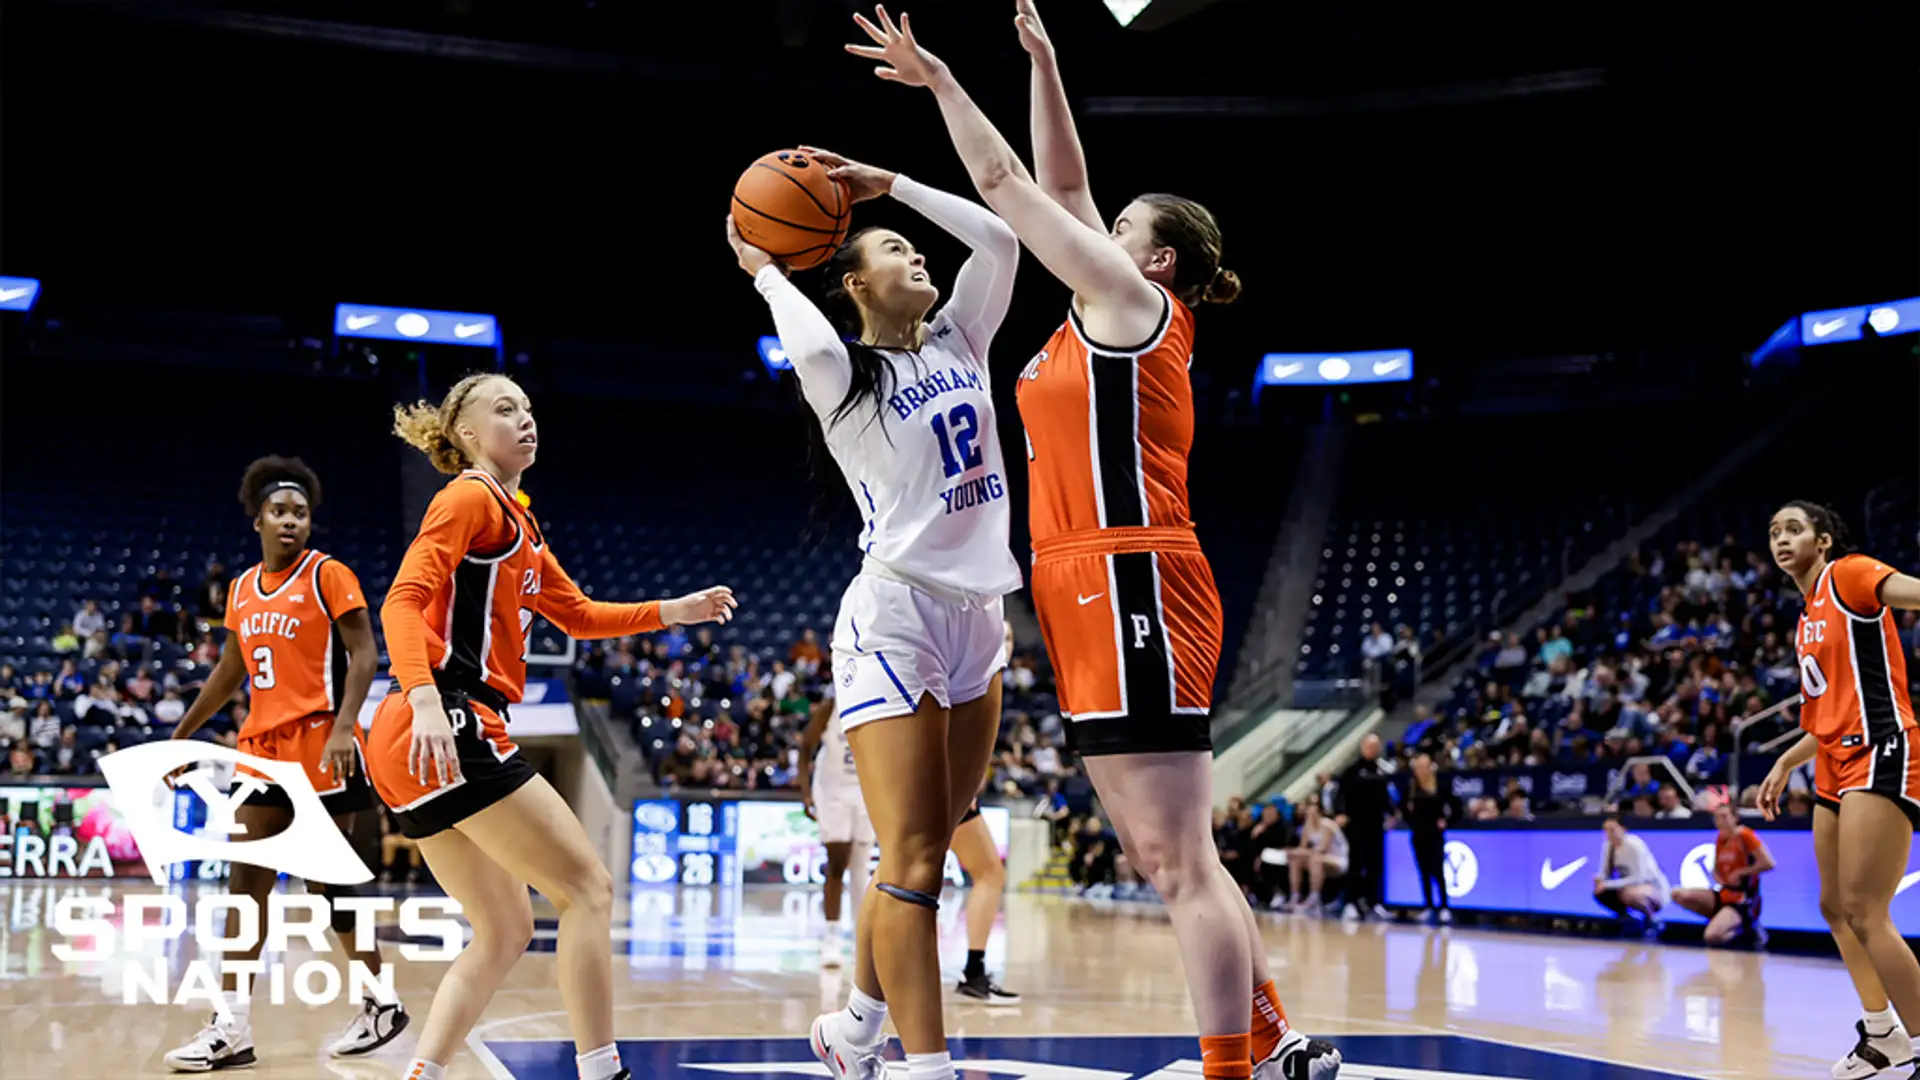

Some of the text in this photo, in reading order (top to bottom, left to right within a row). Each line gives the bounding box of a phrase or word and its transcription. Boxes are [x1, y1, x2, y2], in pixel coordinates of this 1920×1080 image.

[888, 368, 983, 421] BRIGHAM
[930, 403, 983, 479] 12
[940, 473, 1004, 515] YOUNG
[1130, 613, 1150, 648] P
[253, 646, 275, 689] 3
[449, 708, 467, 736] P
